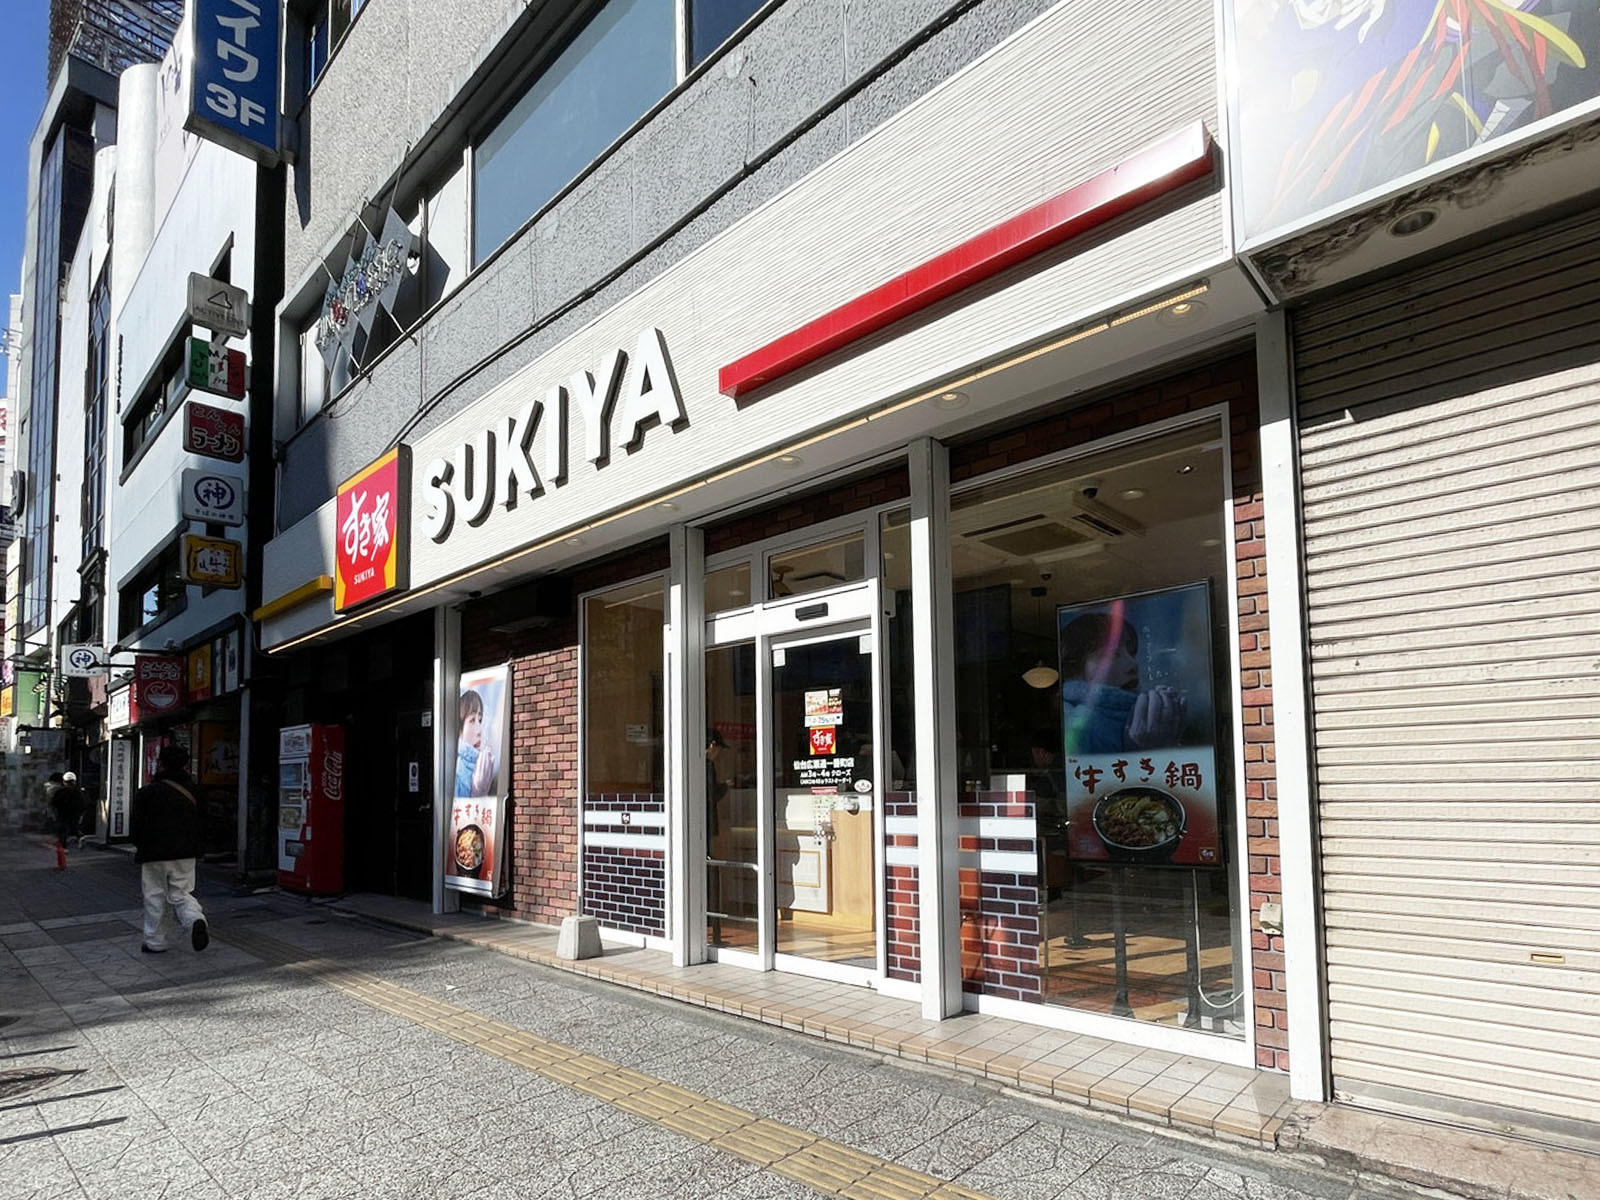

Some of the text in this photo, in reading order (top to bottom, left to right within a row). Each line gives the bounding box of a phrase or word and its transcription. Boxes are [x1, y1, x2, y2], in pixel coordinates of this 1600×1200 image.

[205, 83, 266, 127] 3F
[191, 426, 241, 457] ラーメン
[421, 327, 691, 545] SUKIYA
[202, 481, 227, 505] 神
[342, 489, 390, 564] すき家
[353, 568, 376, 586] SUKIYA
[1074, 758, 1203, 794] 牛すき鍋
[452, 803, 493, 826] 牛すき鍋
